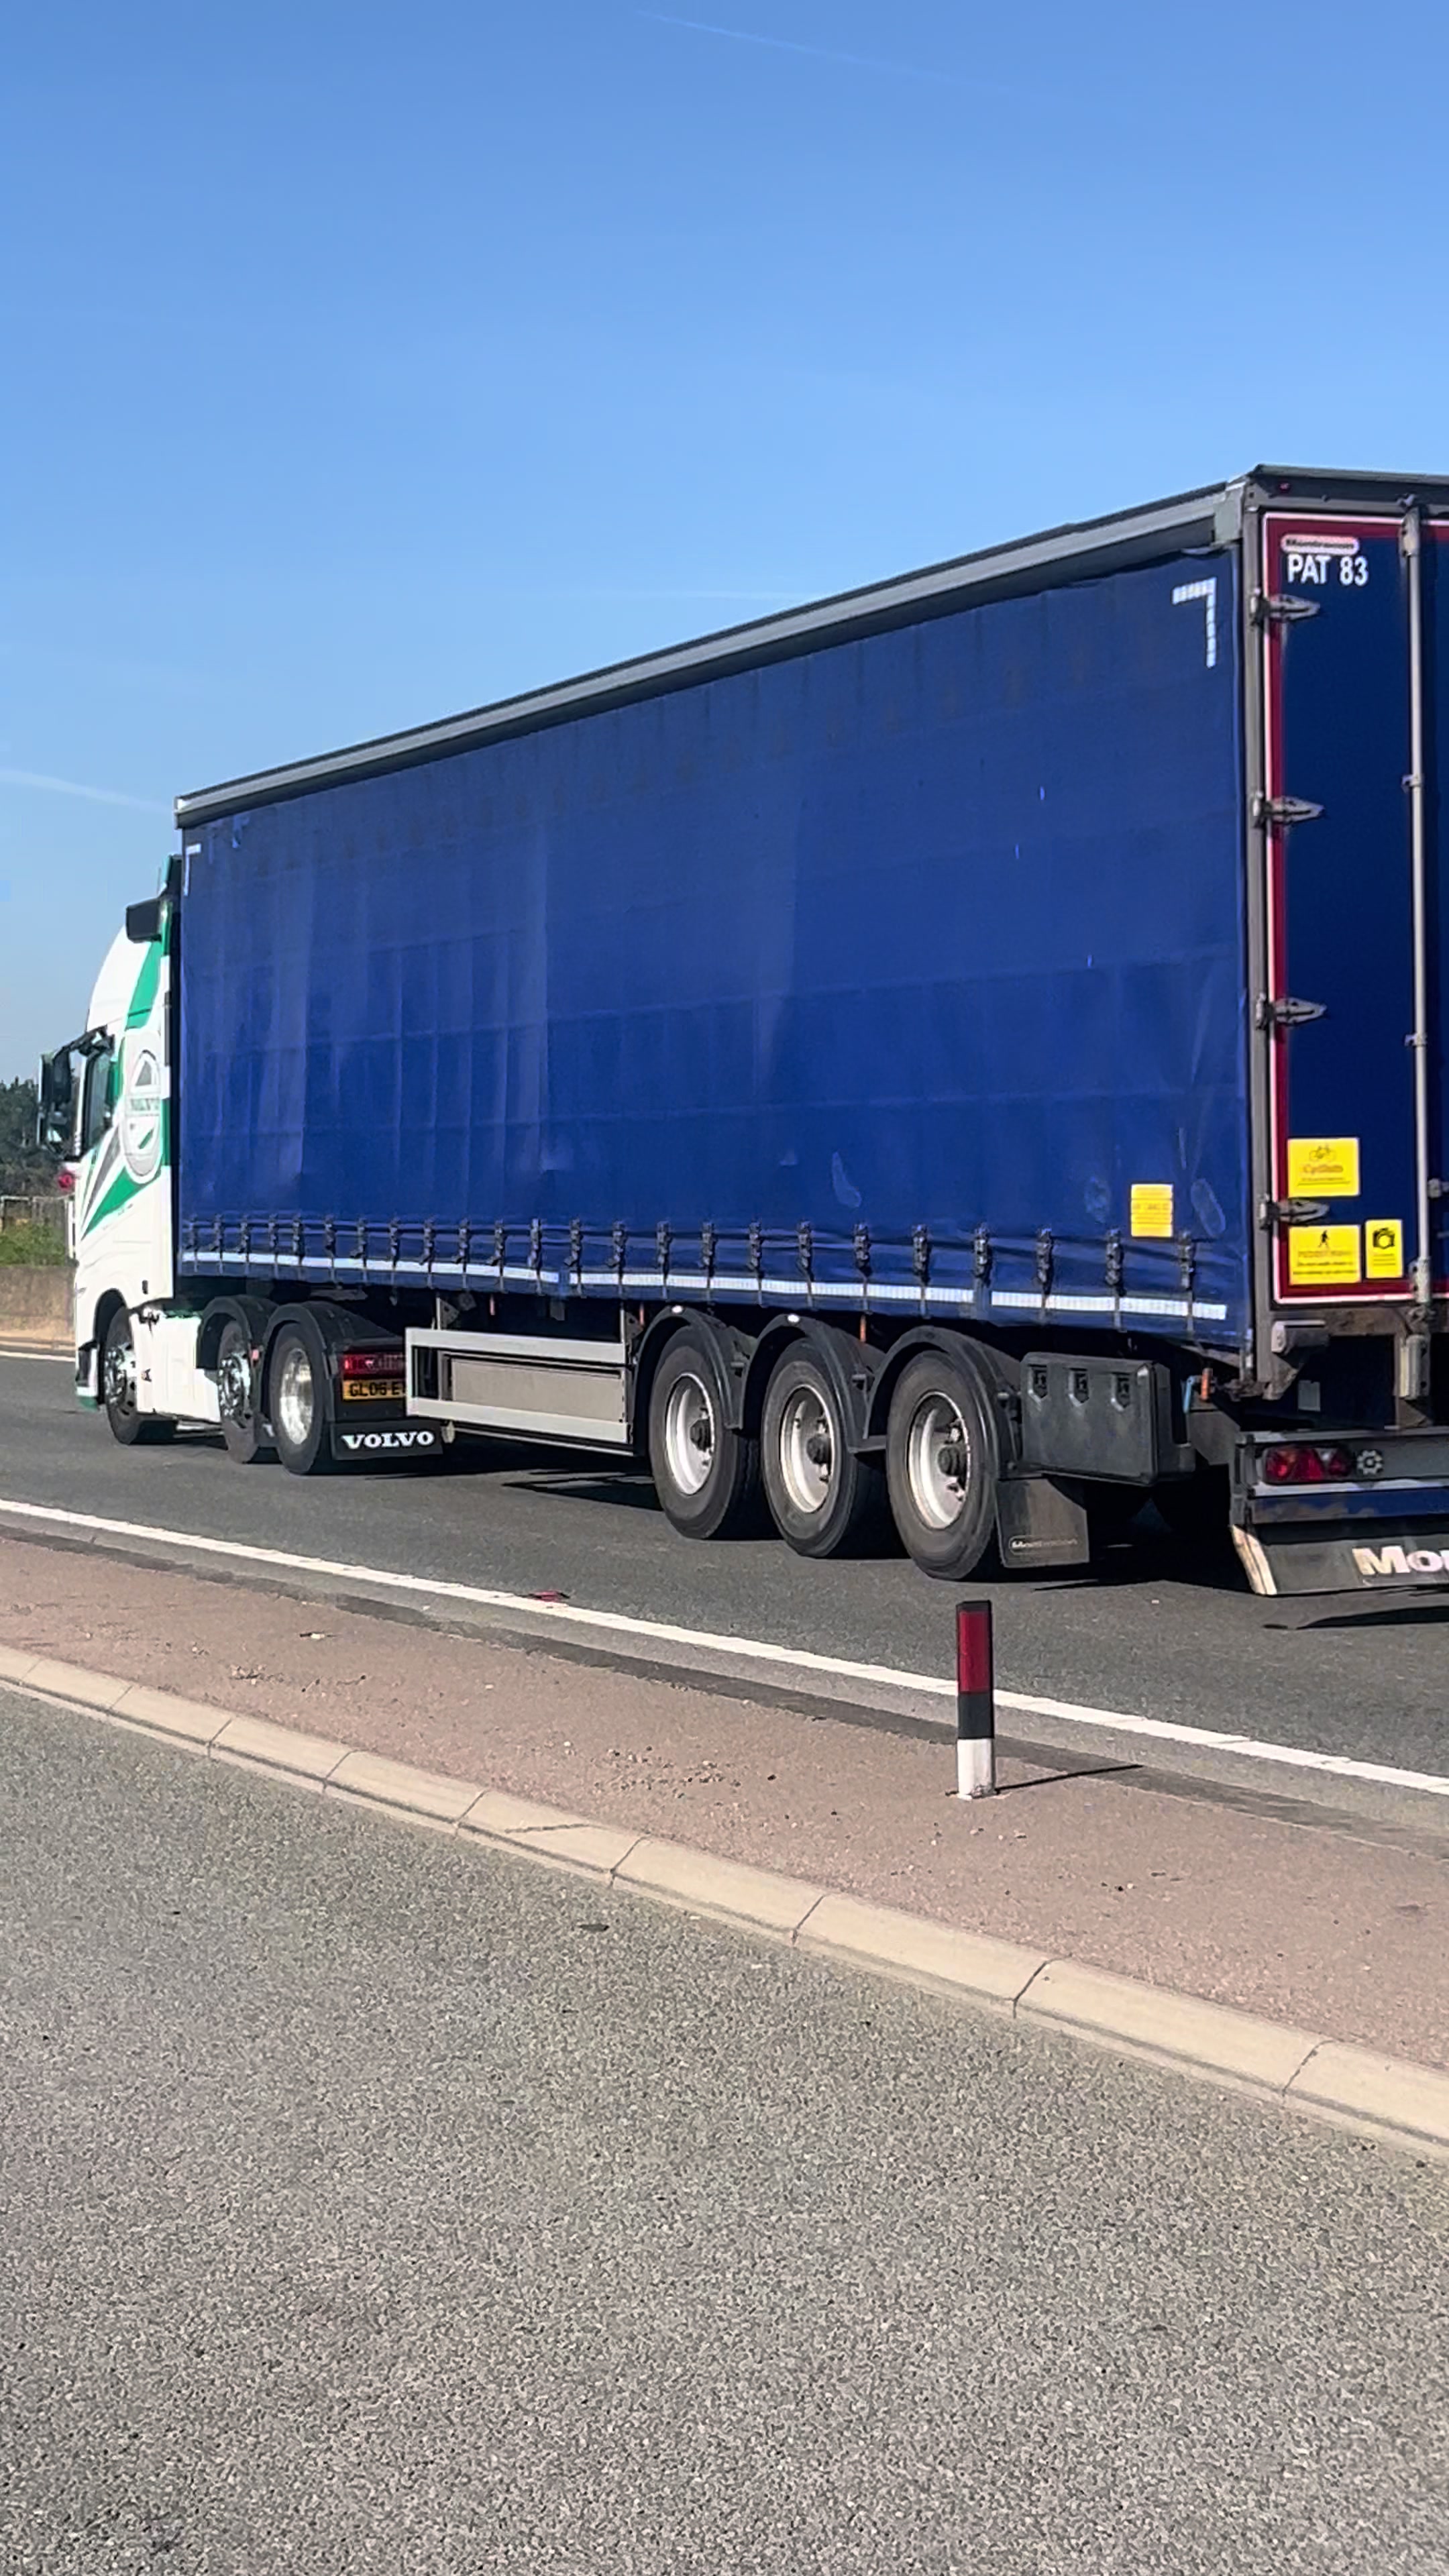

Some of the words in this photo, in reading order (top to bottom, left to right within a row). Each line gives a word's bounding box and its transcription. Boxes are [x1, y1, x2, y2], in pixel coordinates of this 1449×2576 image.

[1287, 553, 1332, 584] PAT
[1339, 555, 1369, 587] 83
[341, 1430, 435, 1450] VOLVO
